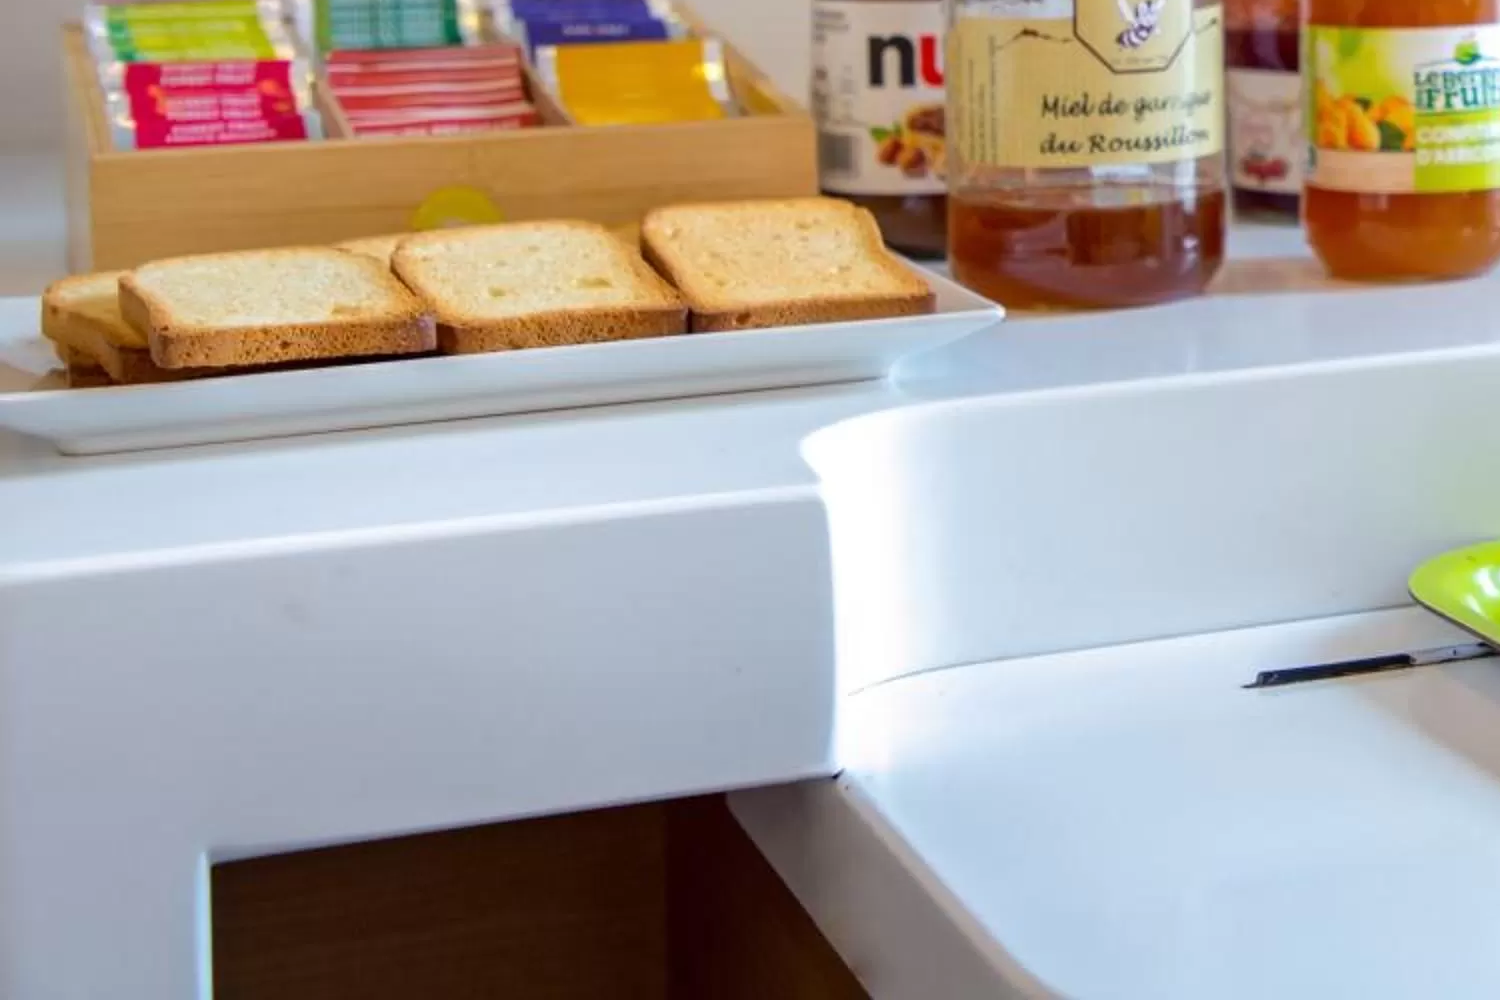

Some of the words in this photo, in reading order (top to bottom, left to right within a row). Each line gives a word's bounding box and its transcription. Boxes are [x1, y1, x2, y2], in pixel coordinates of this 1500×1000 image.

[1041, 91, 1095, 120] Miel
[1098, 90, 1129, 117] de
[1039, 130, 1083, 155] du
